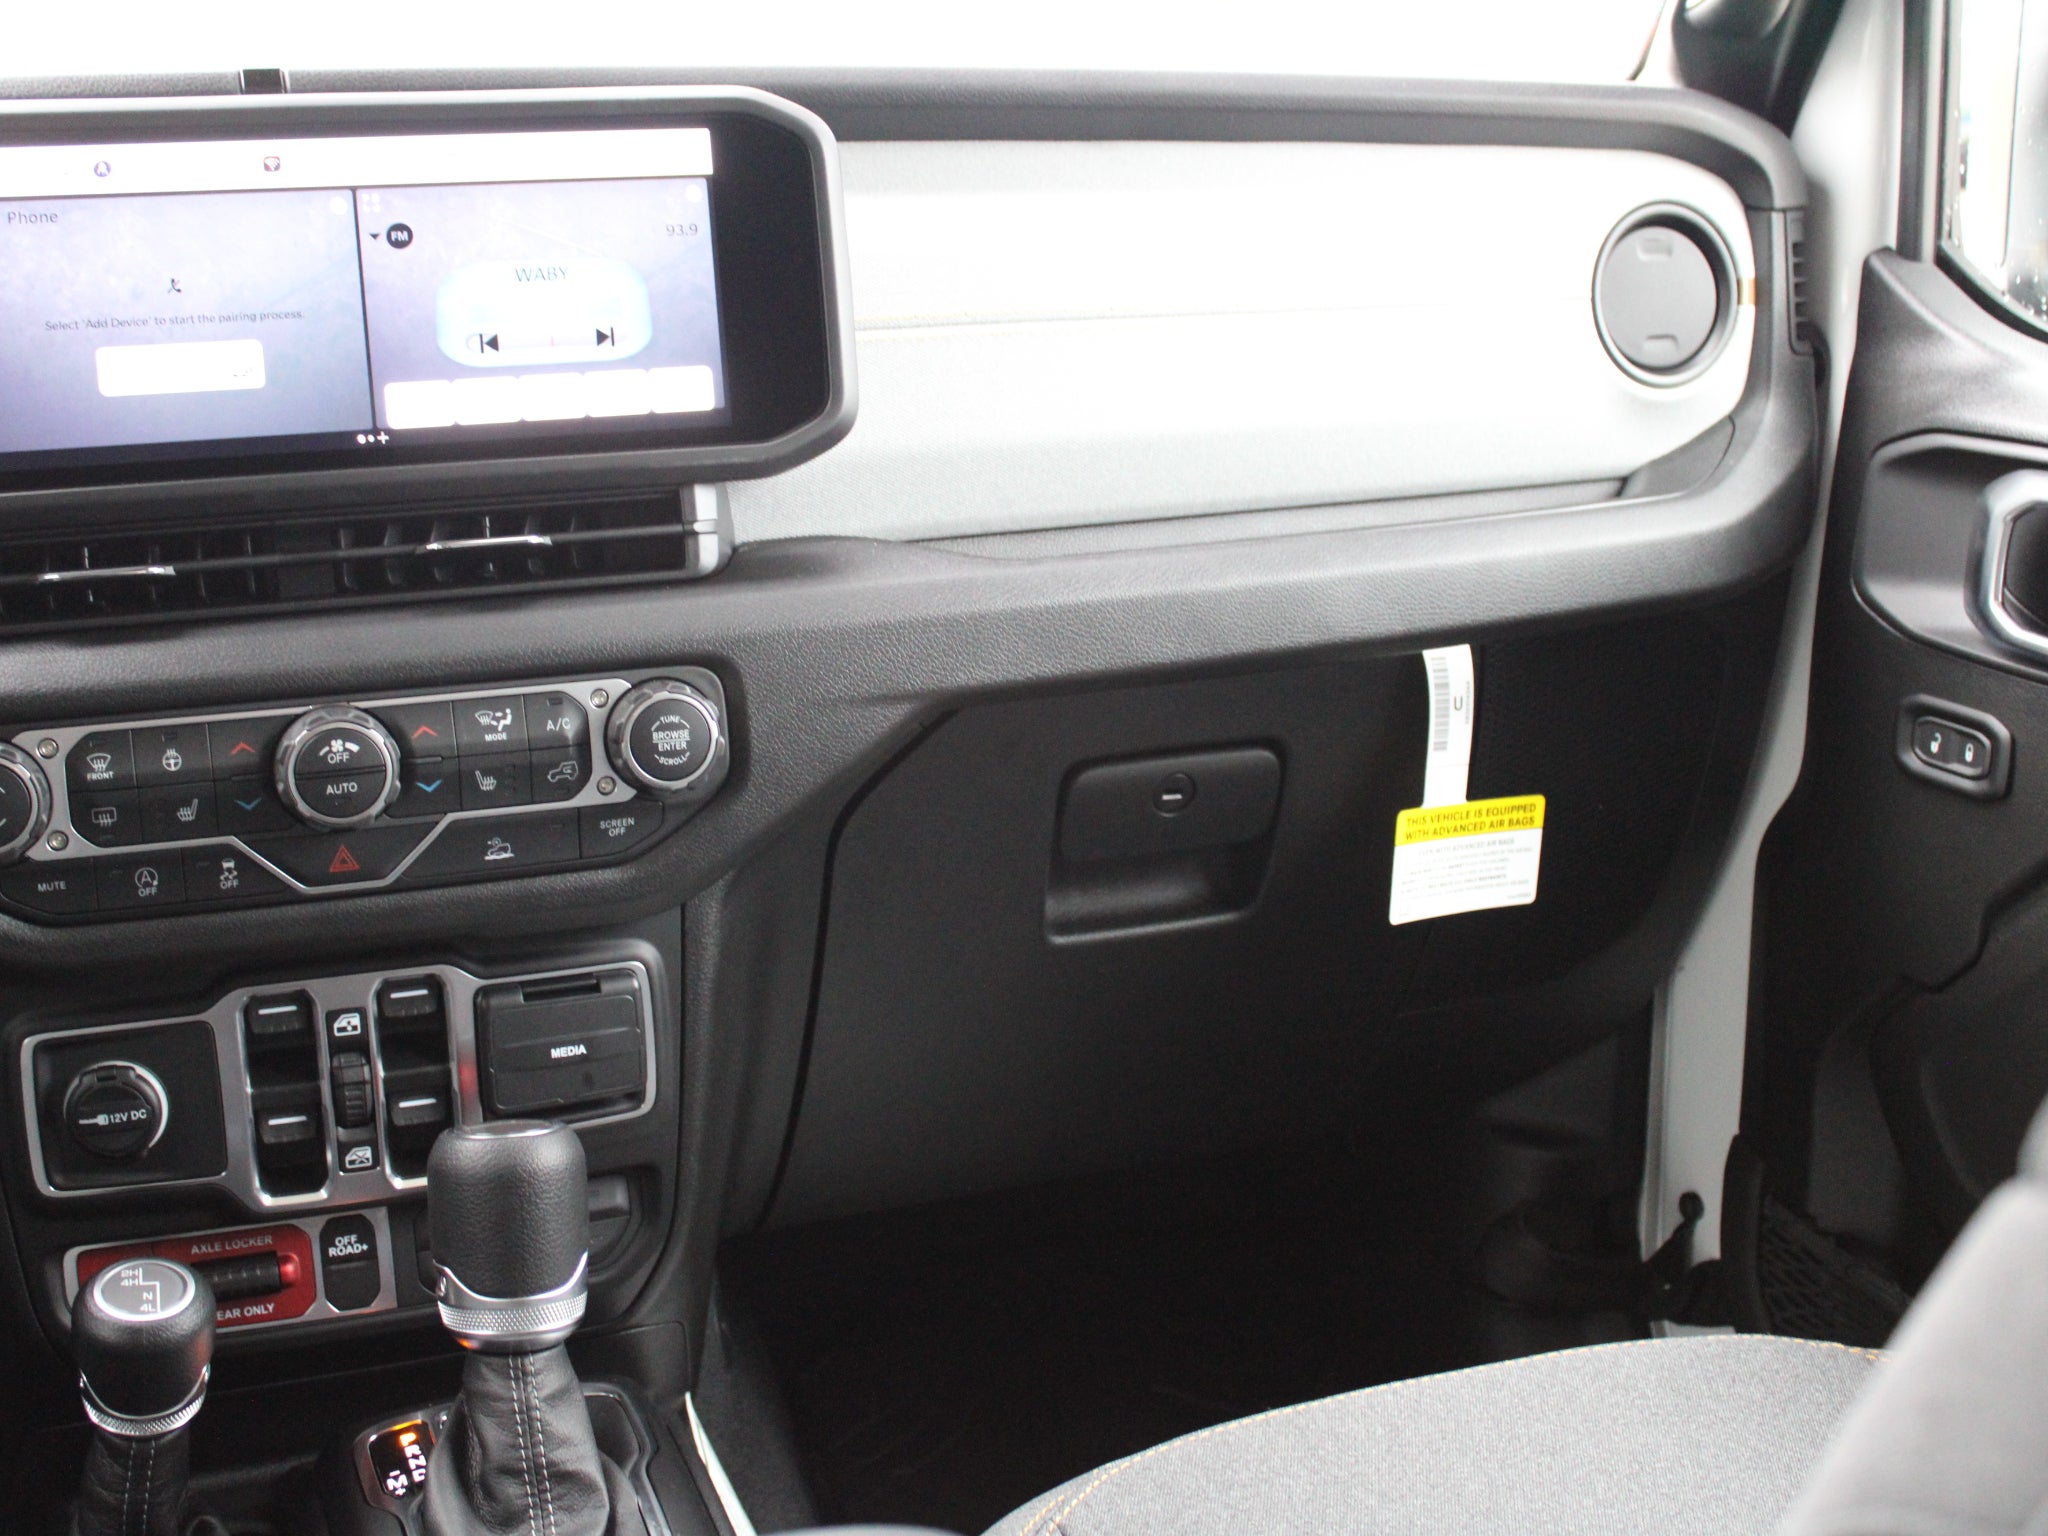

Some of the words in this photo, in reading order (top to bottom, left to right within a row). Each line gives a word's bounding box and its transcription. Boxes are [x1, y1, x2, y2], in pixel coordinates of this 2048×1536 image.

[7, 210, 59, 225] Phone
[666, 222, 699, 237] 93.9
[390, 231, 409, 242] FM
[514, 265, 569, 283] WABY
[45, 320, 80, 332] Select
[155, 316, 167, 326] to
[169, 314, 195, 326] start
[198, 312, 216, 324] the
[218, 311, 257, 325] pairing
[260, 310, 305, 322] process.
[546, 717, 571, 732] A/C
[660, 715, 680, 724] TUNE
[484, 732, 508, 742] MODE
[652, 729, 690, 741] BROWSE
[658, 741, 687, 751] ENTER
[327, 752, 350, 765] OFF
[659, 754, 687, 765] SCROLL
[86, 771, 114, 781] FRONT
[326, 781, 358, 795] AUTO
[1407, 815, 1427, 827] THIS
[1430, 811, 1470, 824] VEHICLE
[1474, 808, 1484, 818] IS
[1486, 803, 1537, 817] EQUIPPED
[600, 817, 635, 829] SCREEN
[1406, 830, 1429, 841] WITH
[1432, 823, 1486, 837] ADVANCED
[1489, 819, 1506, 830] AIR
[1509, 816, 1536, 827] BAGS
[609, 826, 627, 837] OFF
[37, 880, 67, 892] MUTE
[220, 879, 239, 890] OFF
[138, 886, 158, 897] OFF
[550, 1043, 587, 1059] MEDIA
[109, 1112, 128, 1124] 12V
[130, 1108, 147, 1121] DC
[191, 1243, 222, 1255] AXLE
[225, 1234, 273, 1250] LOCKER
[335, 1234, 358, 1246] OFF
[328, 1243, 369, 1258] ROAD+
[120, 1268, 139, 1278] 2H
[120, 1278, 139, 1287] 4H
[143, 1292, 153, 1300] N
[139, 1303, 156, 1312] 4L
[215, 1307, 241, 1320] EAR
[244, 1303, 275, 1317] ONLY
